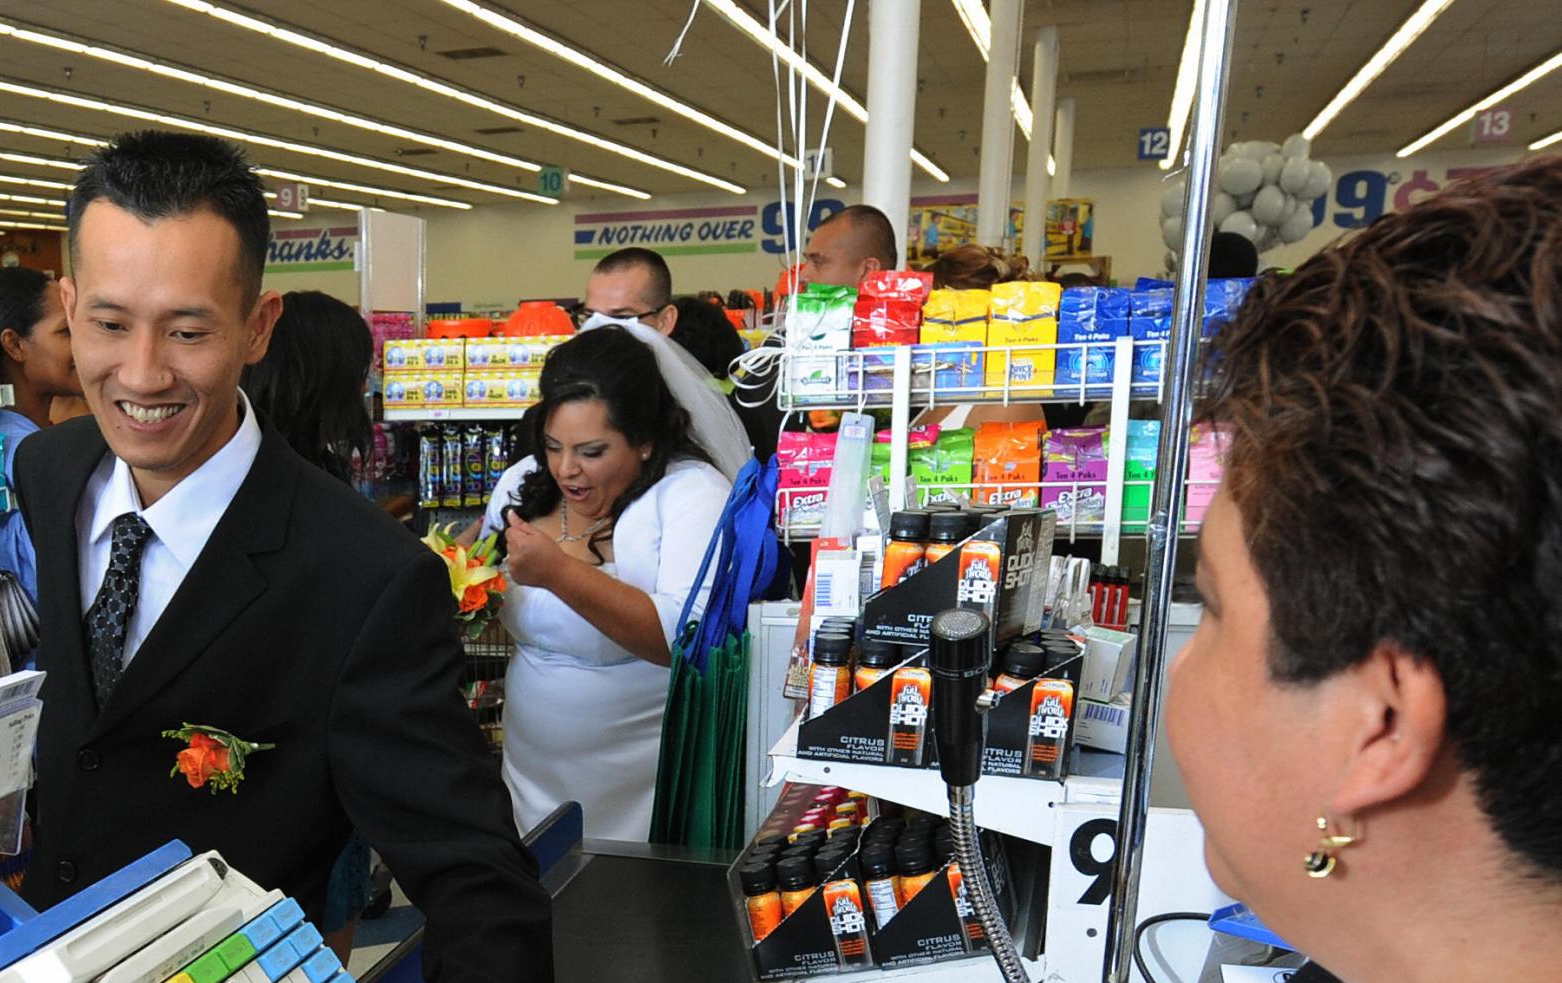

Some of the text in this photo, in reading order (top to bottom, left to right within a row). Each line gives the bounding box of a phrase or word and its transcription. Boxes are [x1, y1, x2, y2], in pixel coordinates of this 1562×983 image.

[1480, 110, 1511, 137] 13
[1141, 131, 1167, 156] 12
[540, 172, 561, 191] 10
[281, 187, 293, 207] 9
[598, 222, 694, 246] NOTHING
[267, 228, 355, 263] hanks.
[919, 475, 932, 483] Ten
[940, 474, 959, 482] Paks
[1056, 471, 1068, 479] Ten
[1078, 470, 1096, 478] Paks
[1128, 471, 1142, 479] Ten
[792, 492, 825, 510] Extra
[1006, 551, 1036, 573] QUICK
[958, 578, 997, 595] QUICK
[1004, 569, 1034, 590] SHOT
[957, 589, 997, 604] SHOT
[891, 703, 928, 718] QUICK
[889, 713, 927, 726] SHOT
[1030, 714, 1069, 731] QUICK
[1028, 725, 1068, 739] SHOT
[840, 735, 886, 747] CITRUS
[846, 744, 885, 752] FLAVOR
[814, 751, 851, 761] ARTIFICIAL
[851, 754, 884, 763] FLAVORS
[827, 747, 851, 755] OTHER
[851, 749, 885, 758] NATURAL
[984, 747, 1023, 758] ITRUS
[987, 766, 1021, 775] FLAVORS
[988, 761, 1022, 770] NATURAL
[1069, 817, 1119, 906] 9
[829, 911, 866, 926] QUICK
[831, 921, 866, 936] SHOT
[917, 933, 962, 947] CITRUS
[925, 940, 963, 951] FLAVOR
[793, 950, 836, 962] CITRUS
[801, 957, 837, 966] FLAVOR
